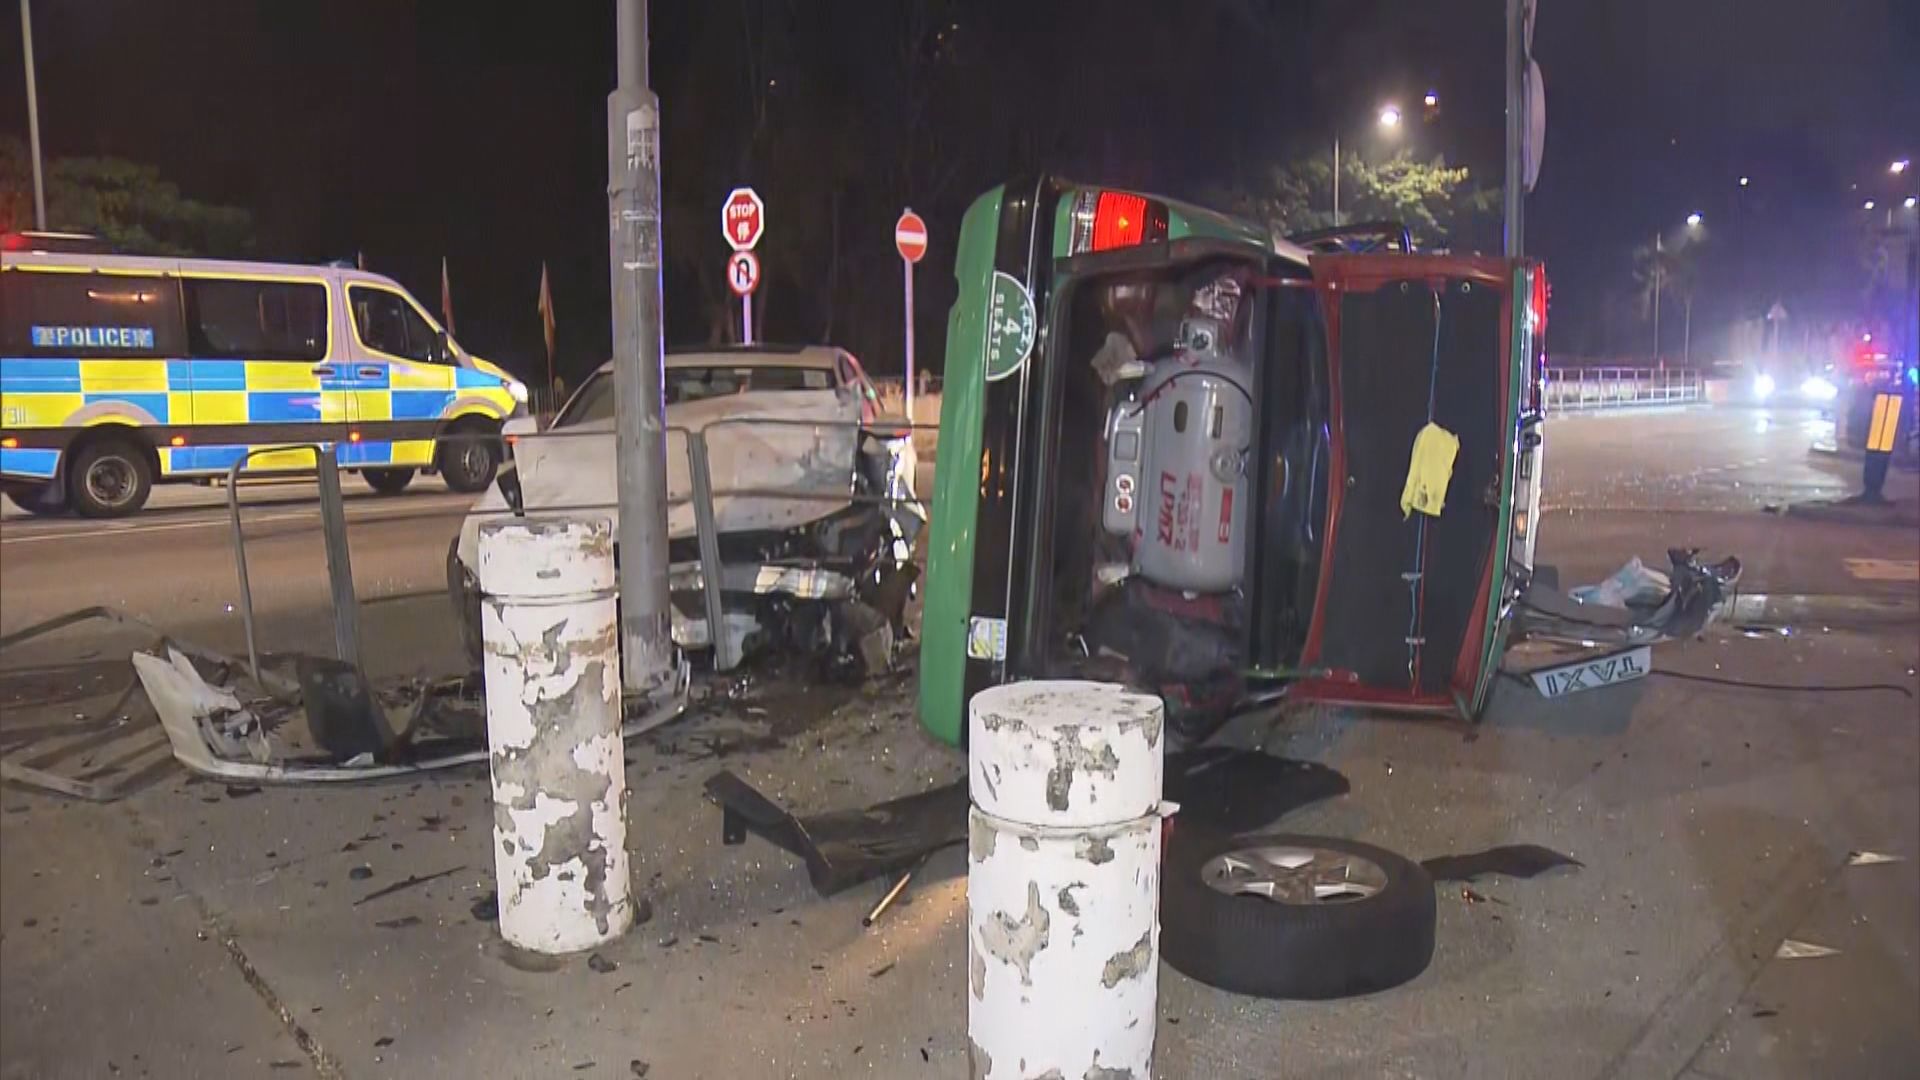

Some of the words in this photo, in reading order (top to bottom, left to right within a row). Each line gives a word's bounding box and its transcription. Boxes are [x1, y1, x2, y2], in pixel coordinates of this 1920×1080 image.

[730, 203, 757, 219] STOP
[990, 293, 1005, 360] SEATS
[1002, 317, 1022, 336] 4
[57, 327, 131, 346] POLICE
[1546, 656, 1643, 697] TAXI
